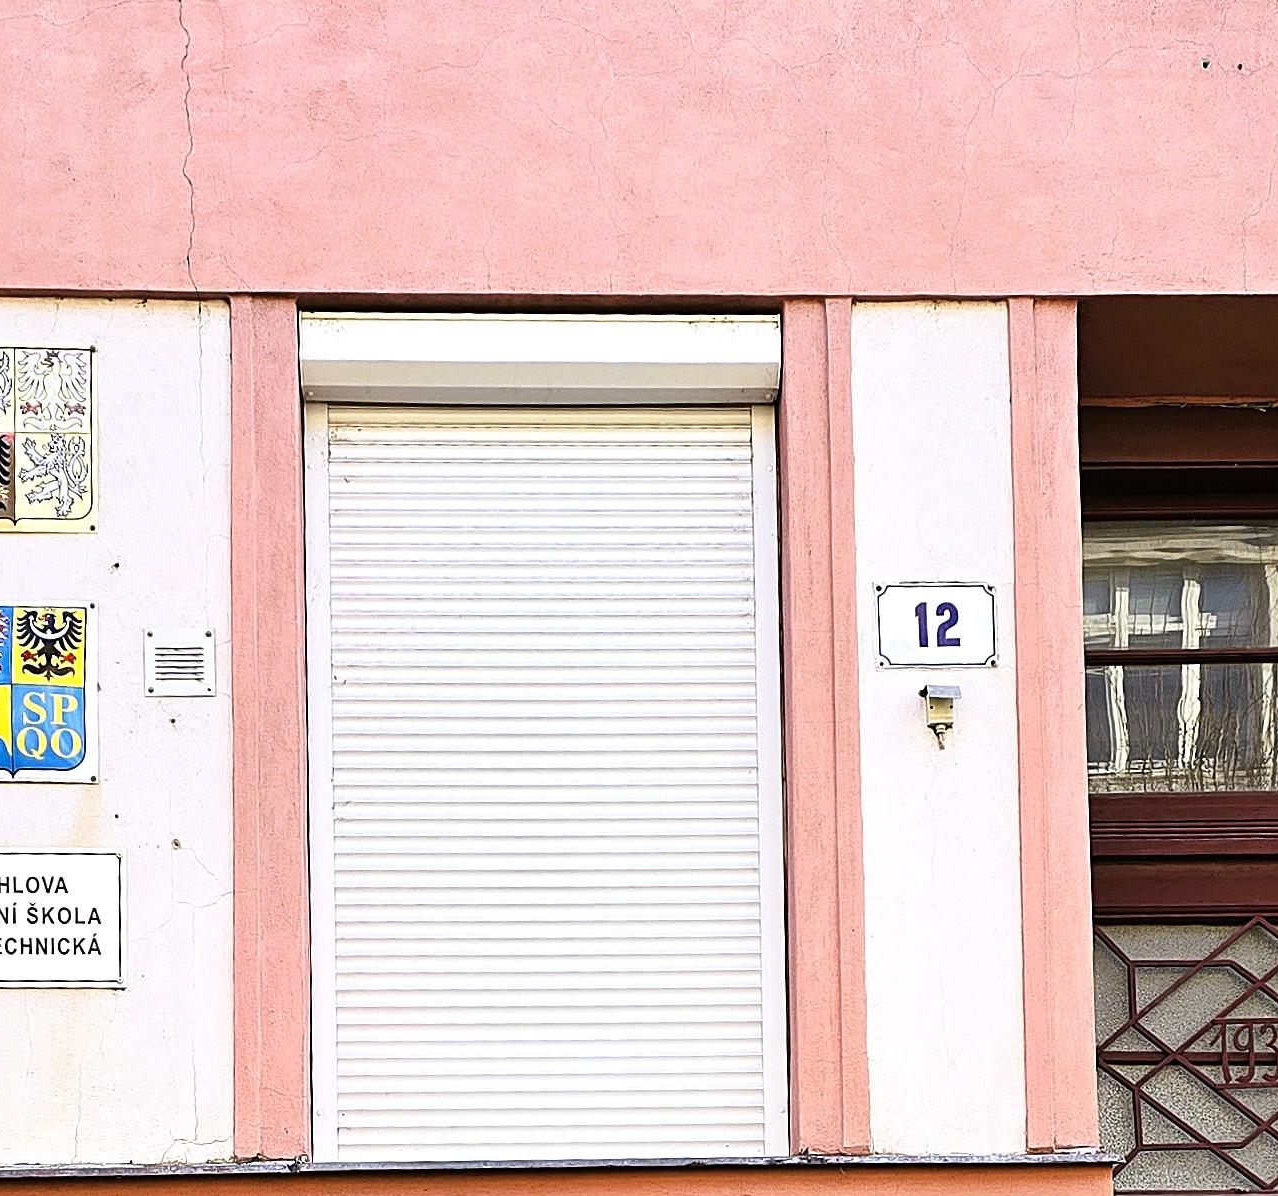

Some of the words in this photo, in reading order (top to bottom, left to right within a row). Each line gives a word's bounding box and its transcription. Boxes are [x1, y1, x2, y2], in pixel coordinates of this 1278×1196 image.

[915, 602, 961, 647] 12
[22, 691, 79, 725] SP
[16, 727, 82, 760] QO
[26, 902, 102, 925] ŠKOLA
